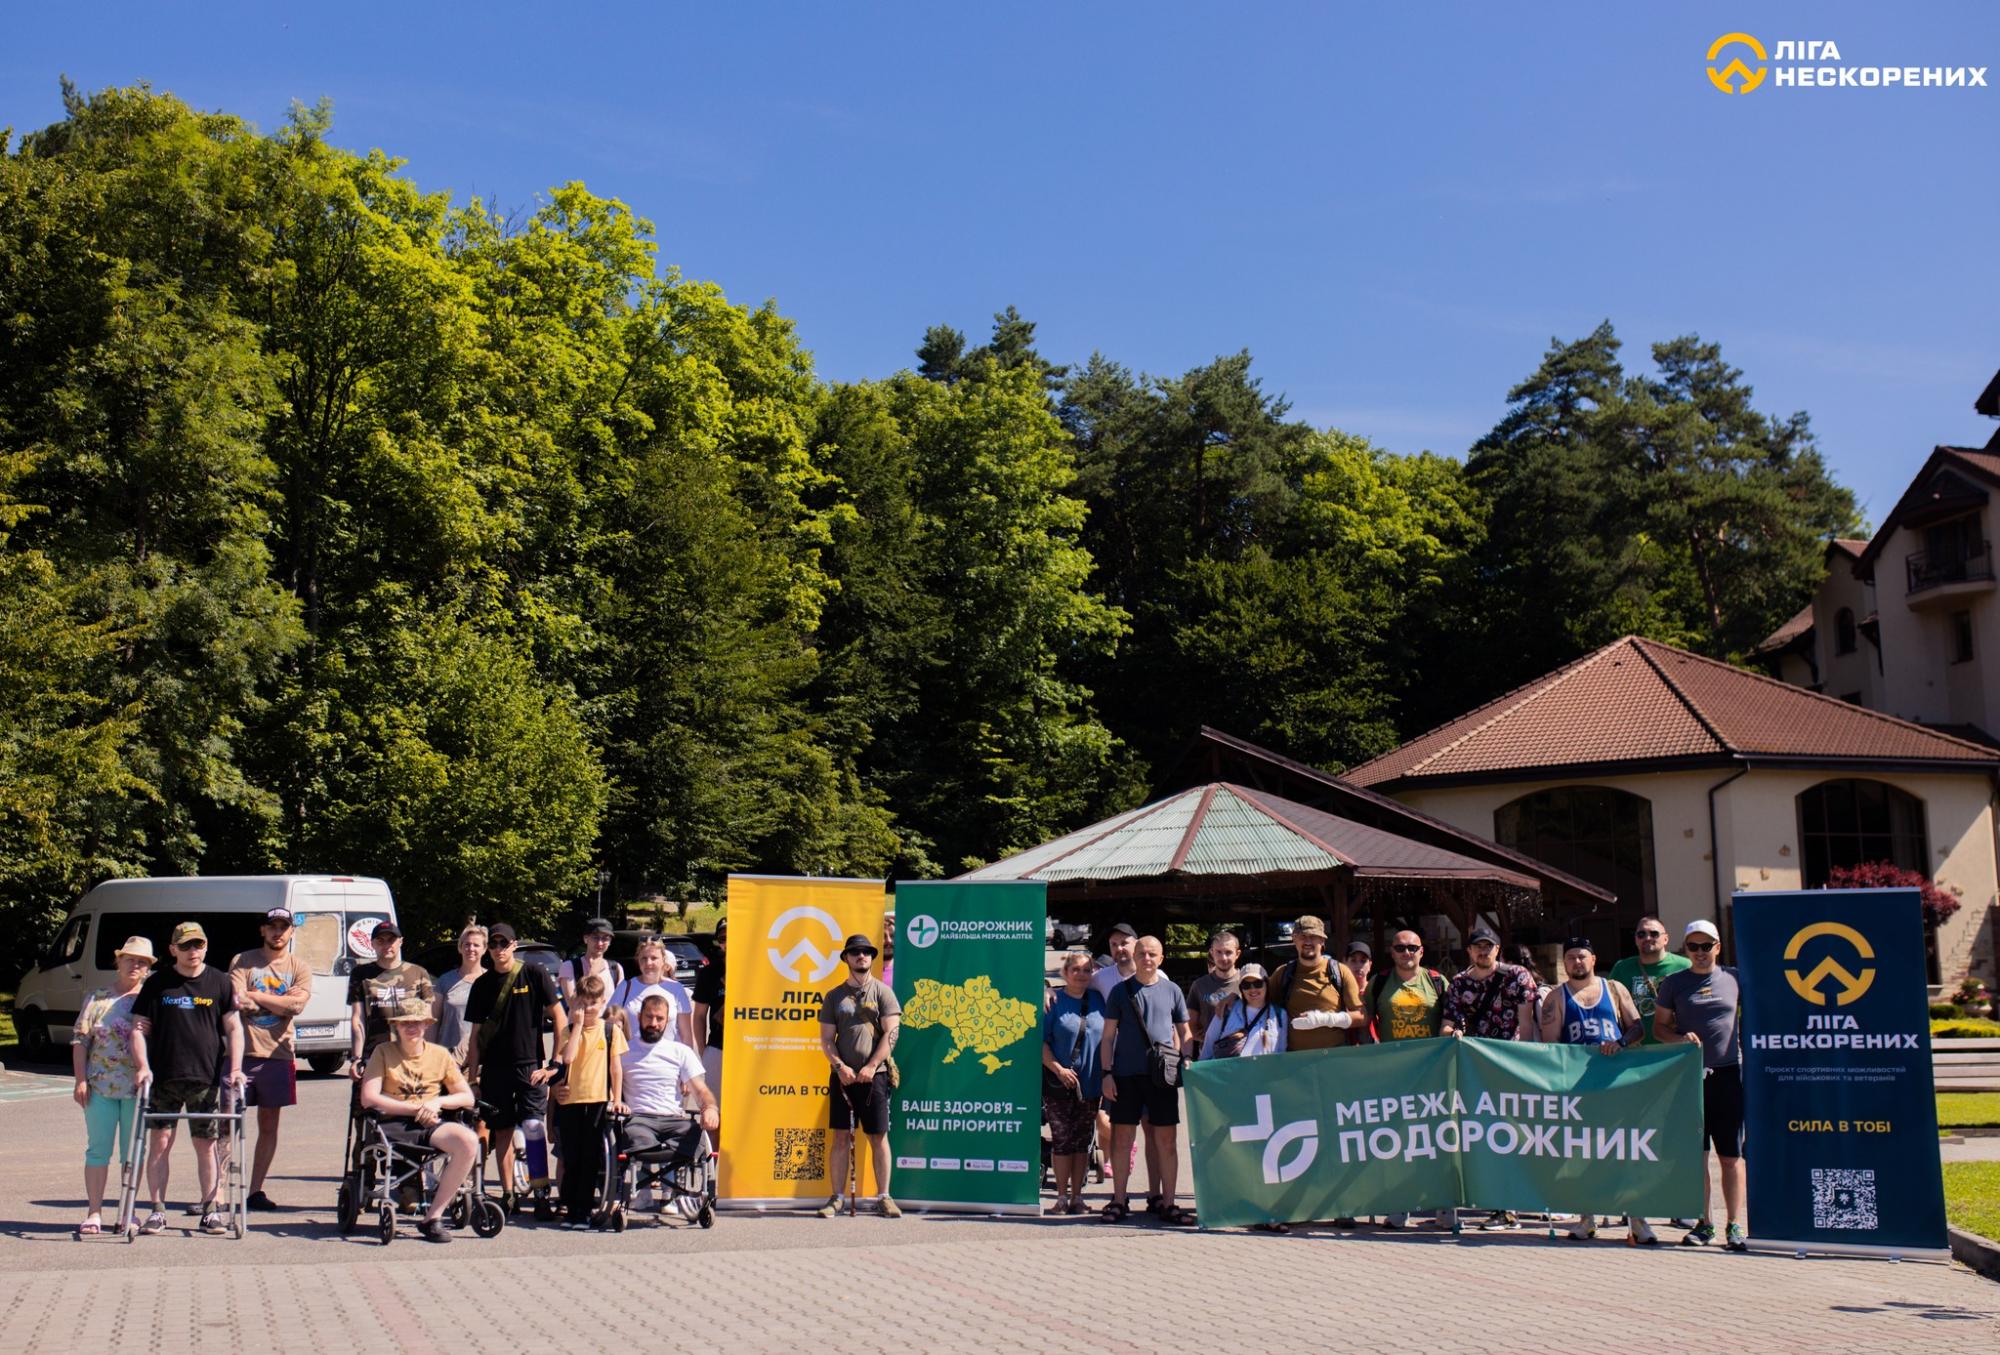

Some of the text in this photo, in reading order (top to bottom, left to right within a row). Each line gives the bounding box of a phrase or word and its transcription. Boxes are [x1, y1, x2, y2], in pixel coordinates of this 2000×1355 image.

[941, 921, 1033, 932] ПОДОРОЖНИК
[941, 932, 980, 940] НАЙБІЛЬША
[193, 996, 213, 1006] Step
[782, 991, 823, 1004] ЛІГА
[1807, 1015, 1859, 1029] ЛІГА
[1568, 1018, 1617, 1042] BSR
[1751, 1034, 1919, 1049] НЕСКОРЕНИХ
[759, 1085, 830, 1096] СИЛА В ТО
[902, 1100, 941, 1112] ВАШЕ
[1335, 1090, 1583, 1126] МЕРЕЖА АПТЕК
[906, 1118, 1022, 1132] НАШ ПРІОРИТЕТ
[1788, 1120, 1891, 1133] СИЛА В ТОБІ
[1339, 1120, 1659, 1163] ПОДОРОЖНИК
